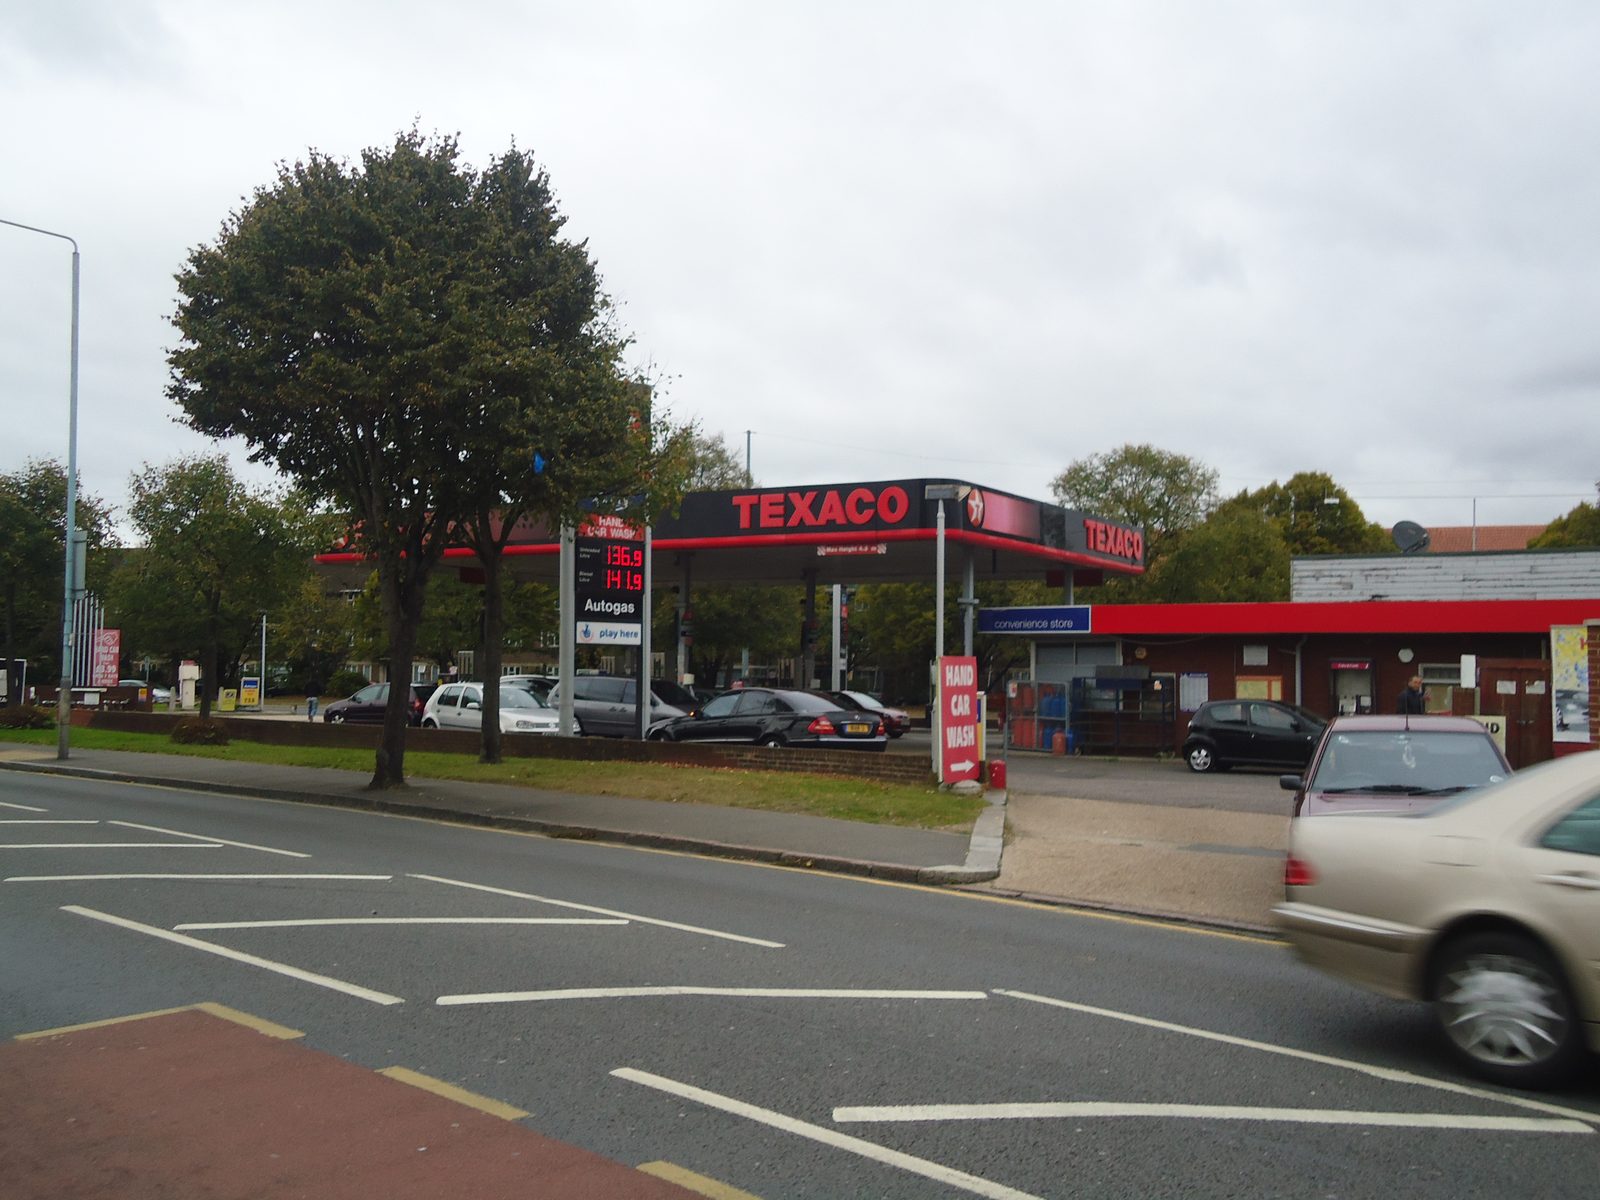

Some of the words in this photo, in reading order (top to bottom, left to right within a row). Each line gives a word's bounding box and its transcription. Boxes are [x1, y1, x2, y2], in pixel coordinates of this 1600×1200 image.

[731, 485, 909, 529] TEXACO
[1083, 518, 1143, 561] TEXACO
[607, 545, 643, 567] 136.9
[606, 569, 642, 591] 141.9
[584, 598, 635, 616] Autogas
[599, 629, 618, 640] play
[619, 629, 639, 638] here
[994, 619, 1048, 630] convenience
[1049, 619, 1074, 629] store
[945, 665, 974, 687] HAND
[951, 694, 971, 717] CAR
[946, 725, 975, 749] WASH
